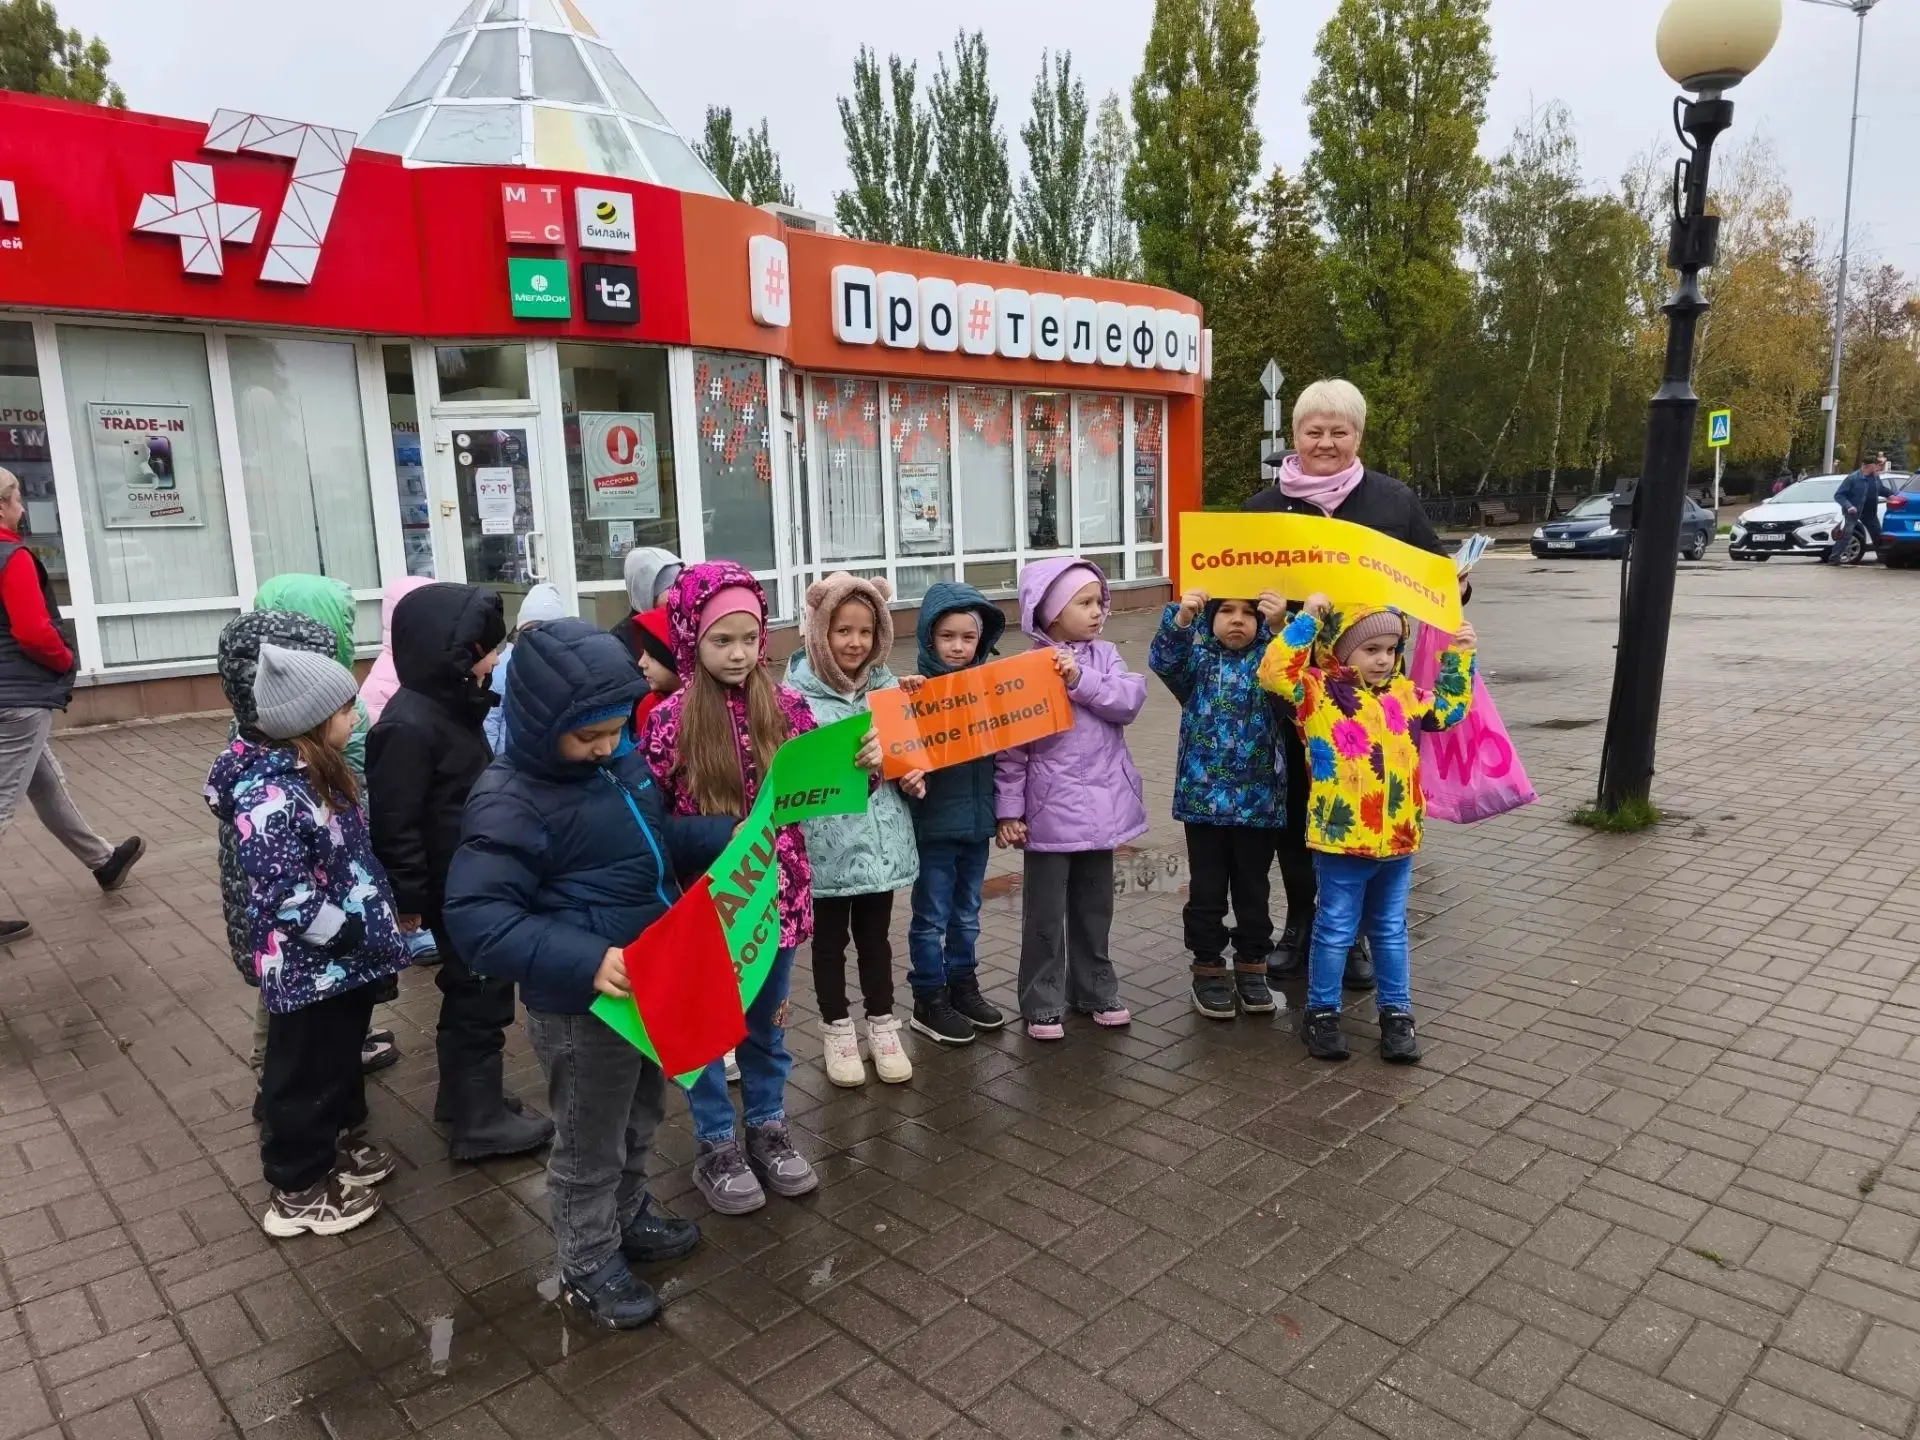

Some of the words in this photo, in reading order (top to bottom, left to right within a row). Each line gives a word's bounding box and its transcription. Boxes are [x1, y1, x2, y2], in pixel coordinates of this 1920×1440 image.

[132, 108, 358, 285] +7
[587, 225, 630, 240] билайн
[600, 278, 632, 308] t2
[100, 417, 184, 431] TRADE-IN
[128, 491, 180, 502] ОБМЕНЯЙ
[598, 476, 635, 487] РАССРОЧКА
[1191, 546, 1351, 572] Соблюдайте
[1357, 554, 1447, 608] скорость!
[901, 692, 979, 721] Жизнь
[994, 678, 1025, 697] это
[890, 727, 961, 756] самое
[968, 698, 1050, 737] главное!
